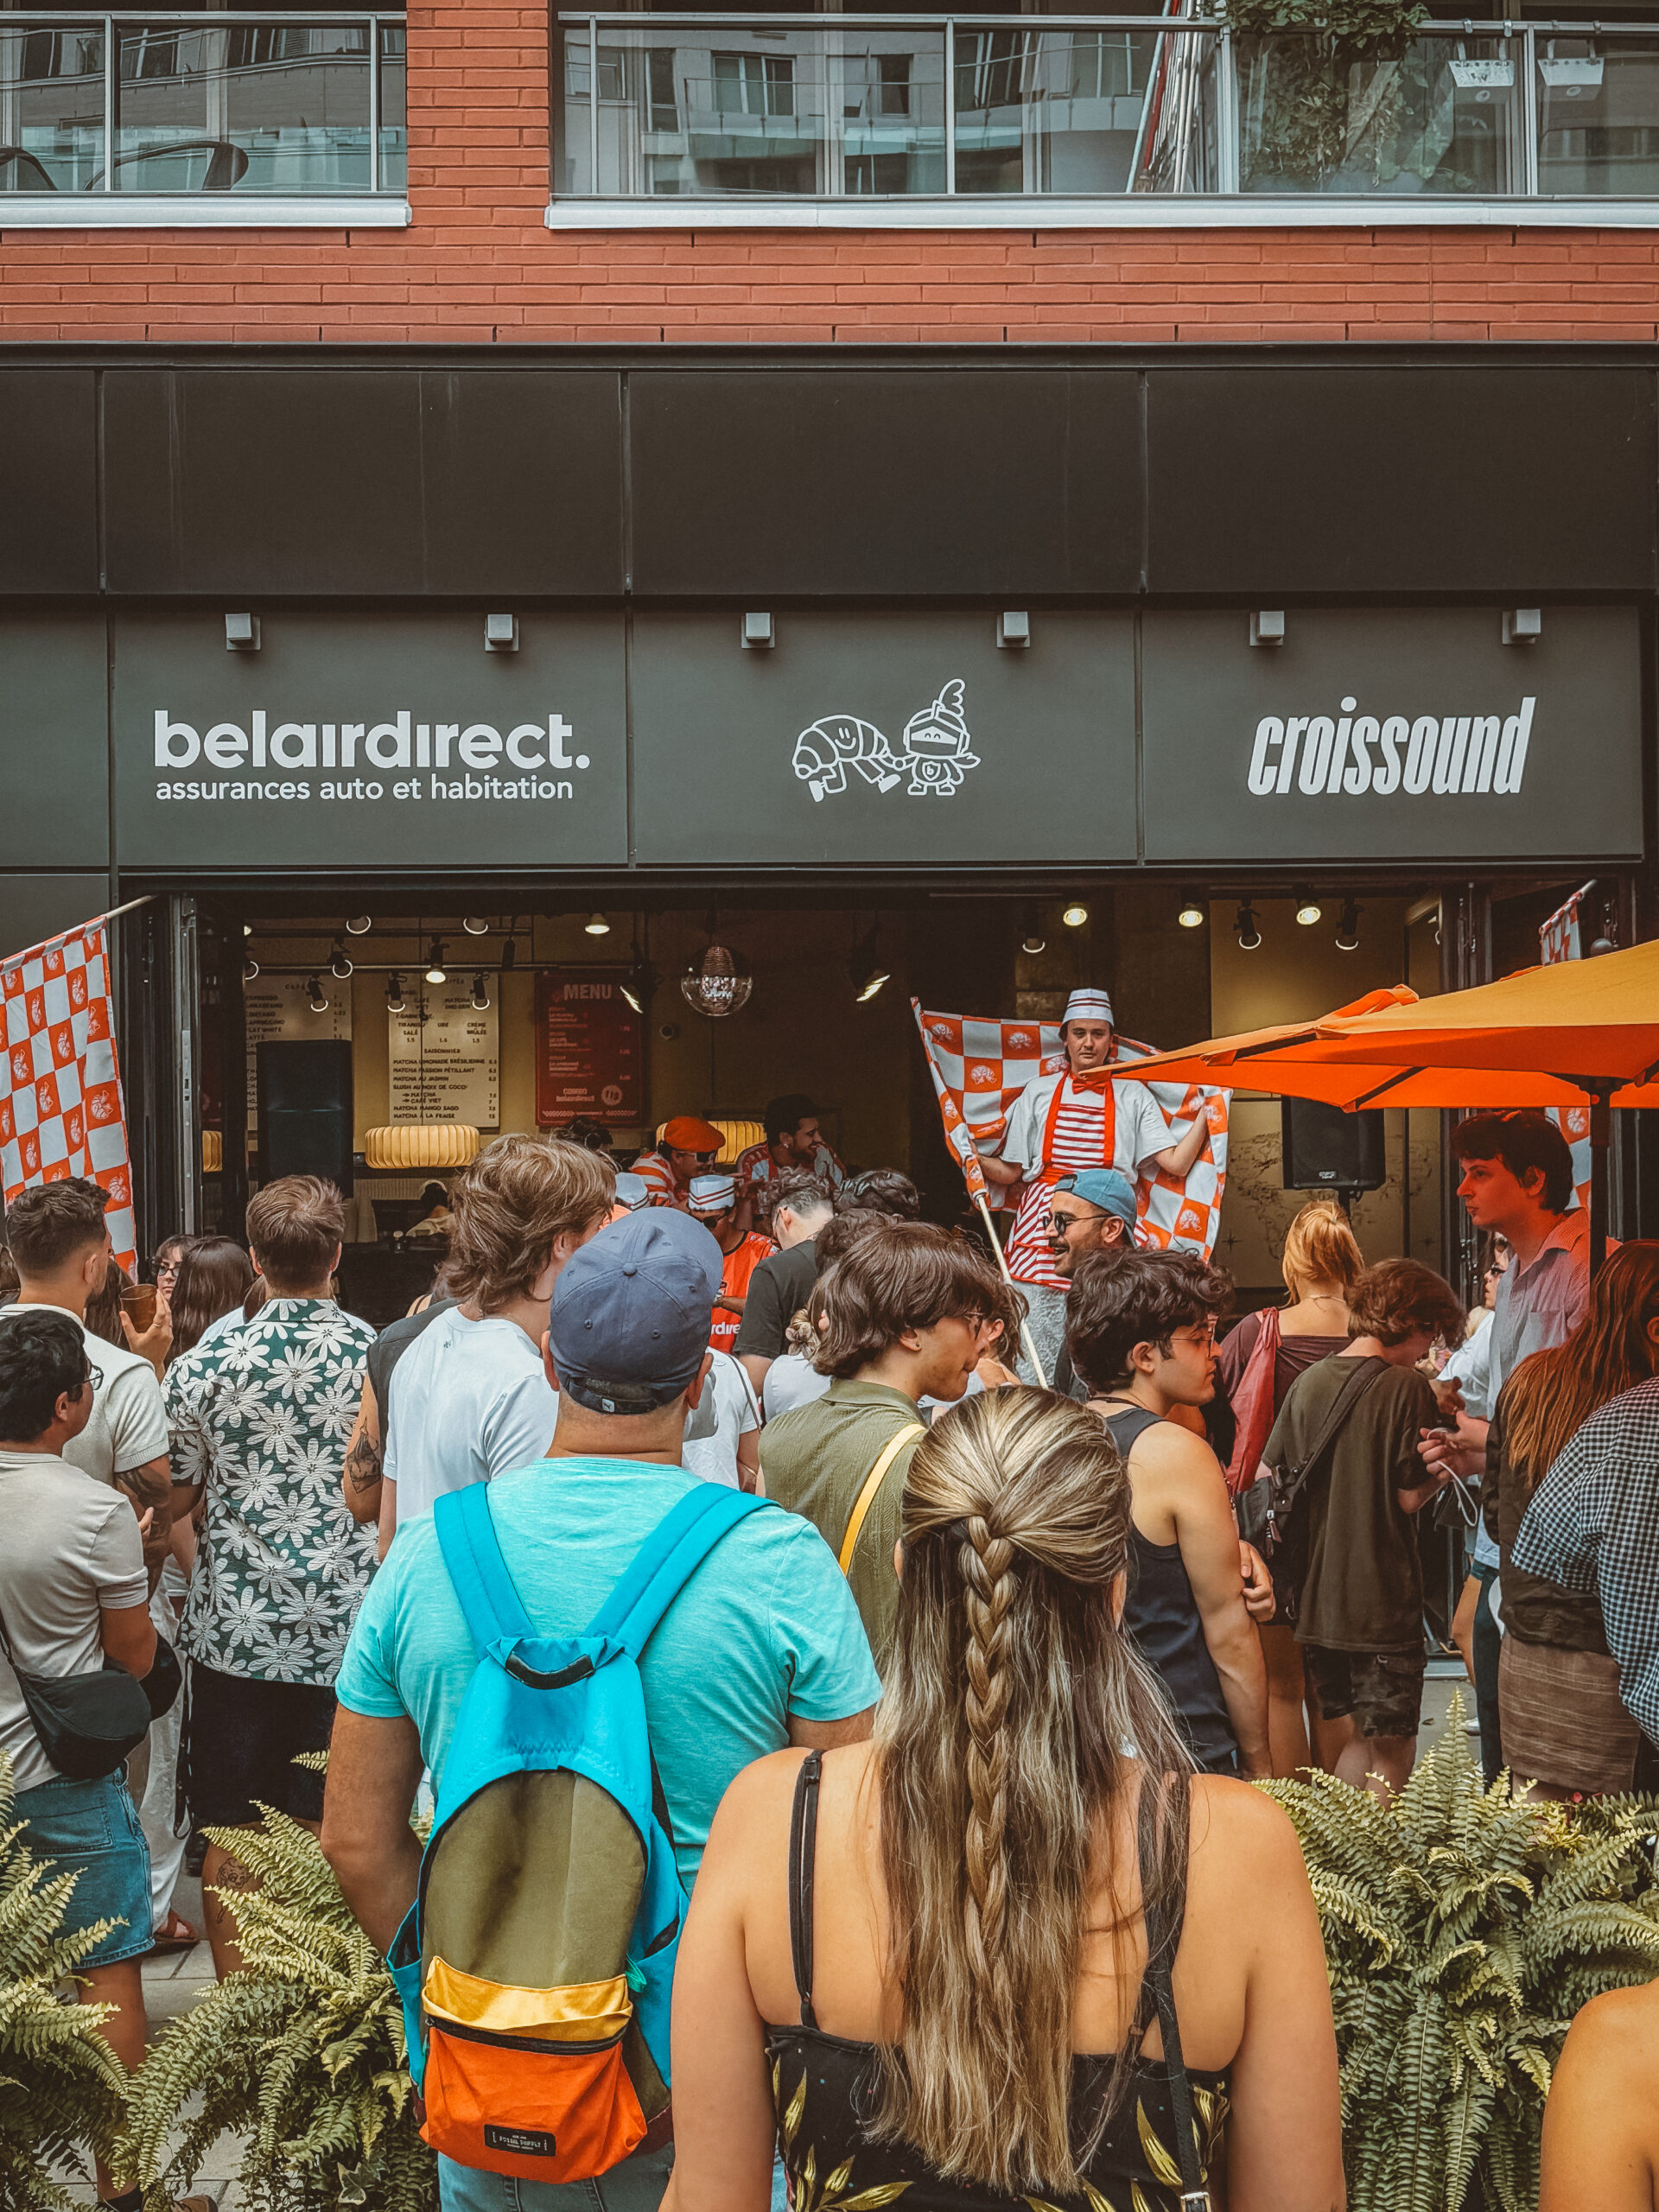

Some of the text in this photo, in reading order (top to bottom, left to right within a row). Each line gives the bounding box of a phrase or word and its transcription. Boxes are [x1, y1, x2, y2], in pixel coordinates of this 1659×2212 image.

[1247, 696, 1537, 796] croissound
[156, 772, 574, 800] assurances auto et habitation
[563, 984, 612, 1000] MENU
